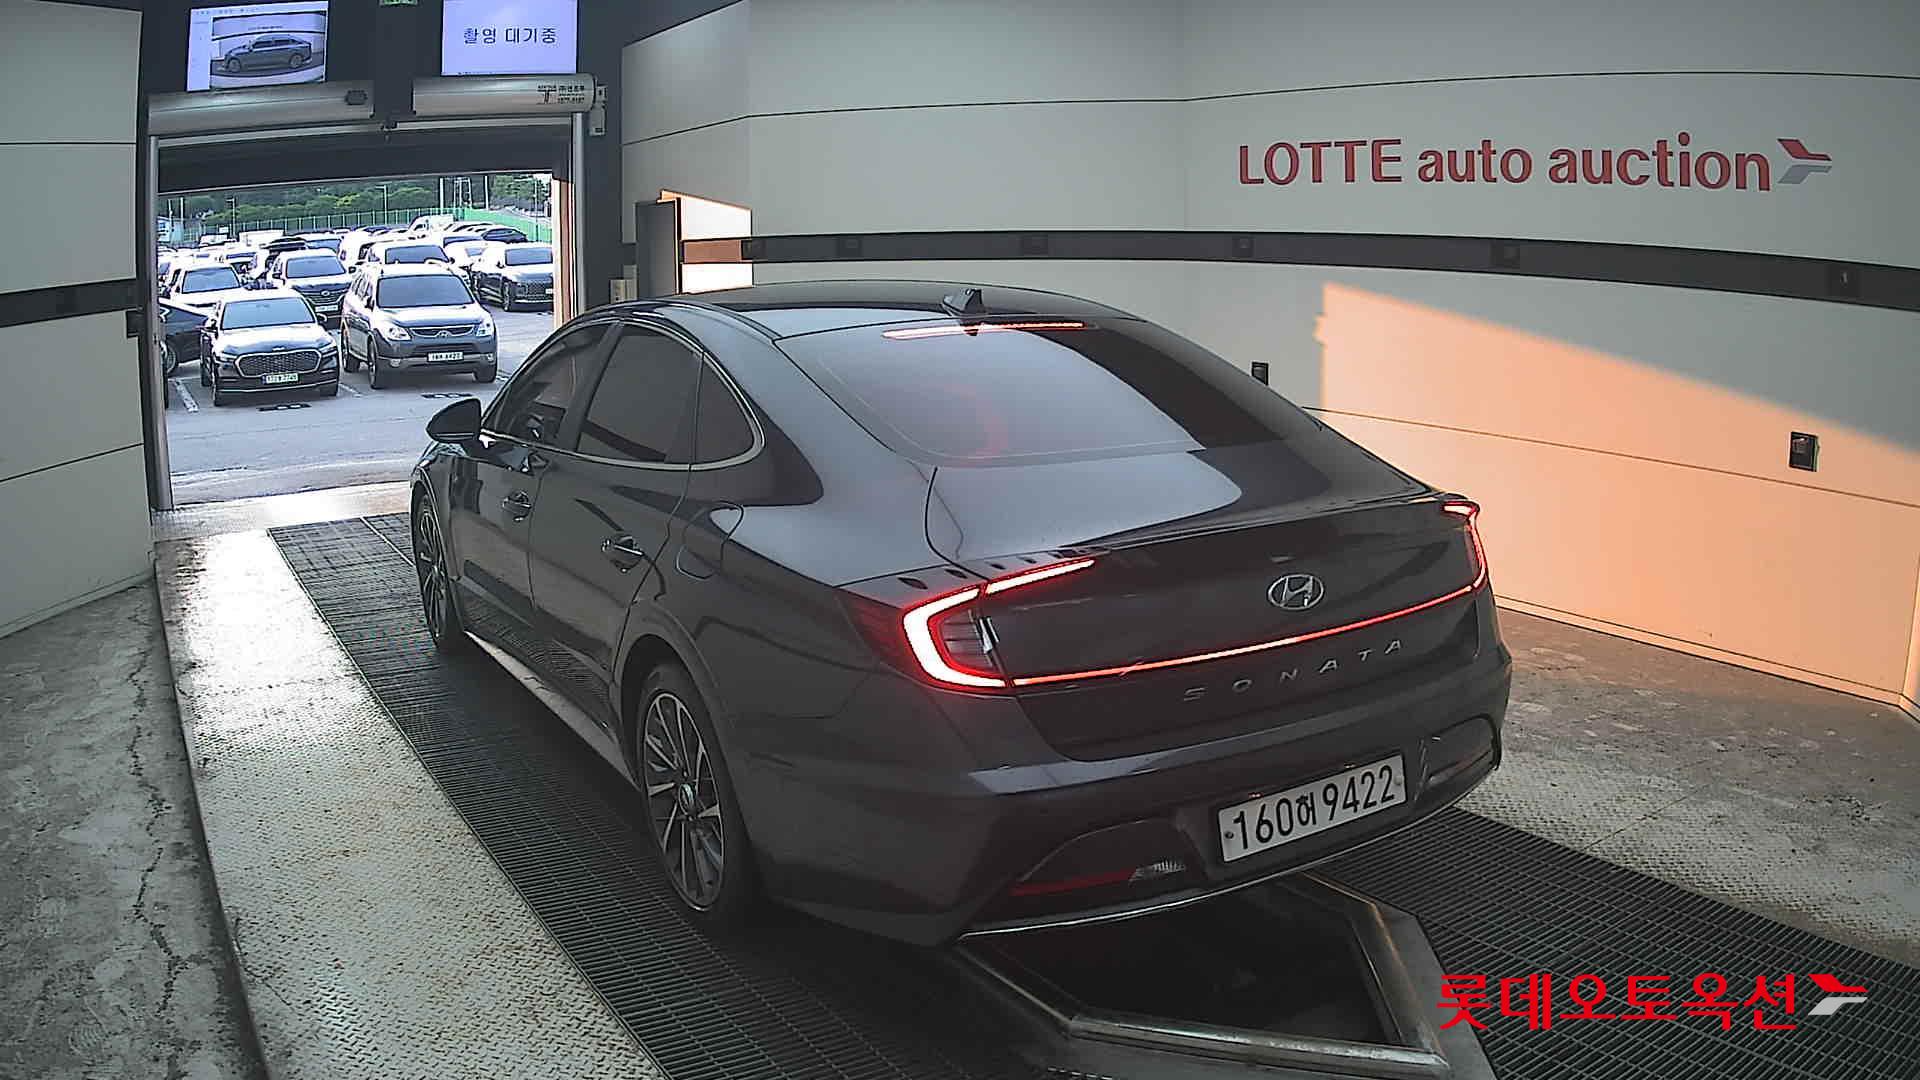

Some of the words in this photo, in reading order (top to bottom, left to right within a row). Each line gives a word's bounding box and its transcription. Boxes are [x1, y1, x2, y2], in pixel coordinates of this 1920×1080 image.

[505, 27, 557, 44] 대기중
[1239, 139, 1402, 185] LOTTE
[1417, 139, 1533, 184] auto
[1548, 131, 1771, 191] auction
[1184, 639, 1402, 701] SONATA
